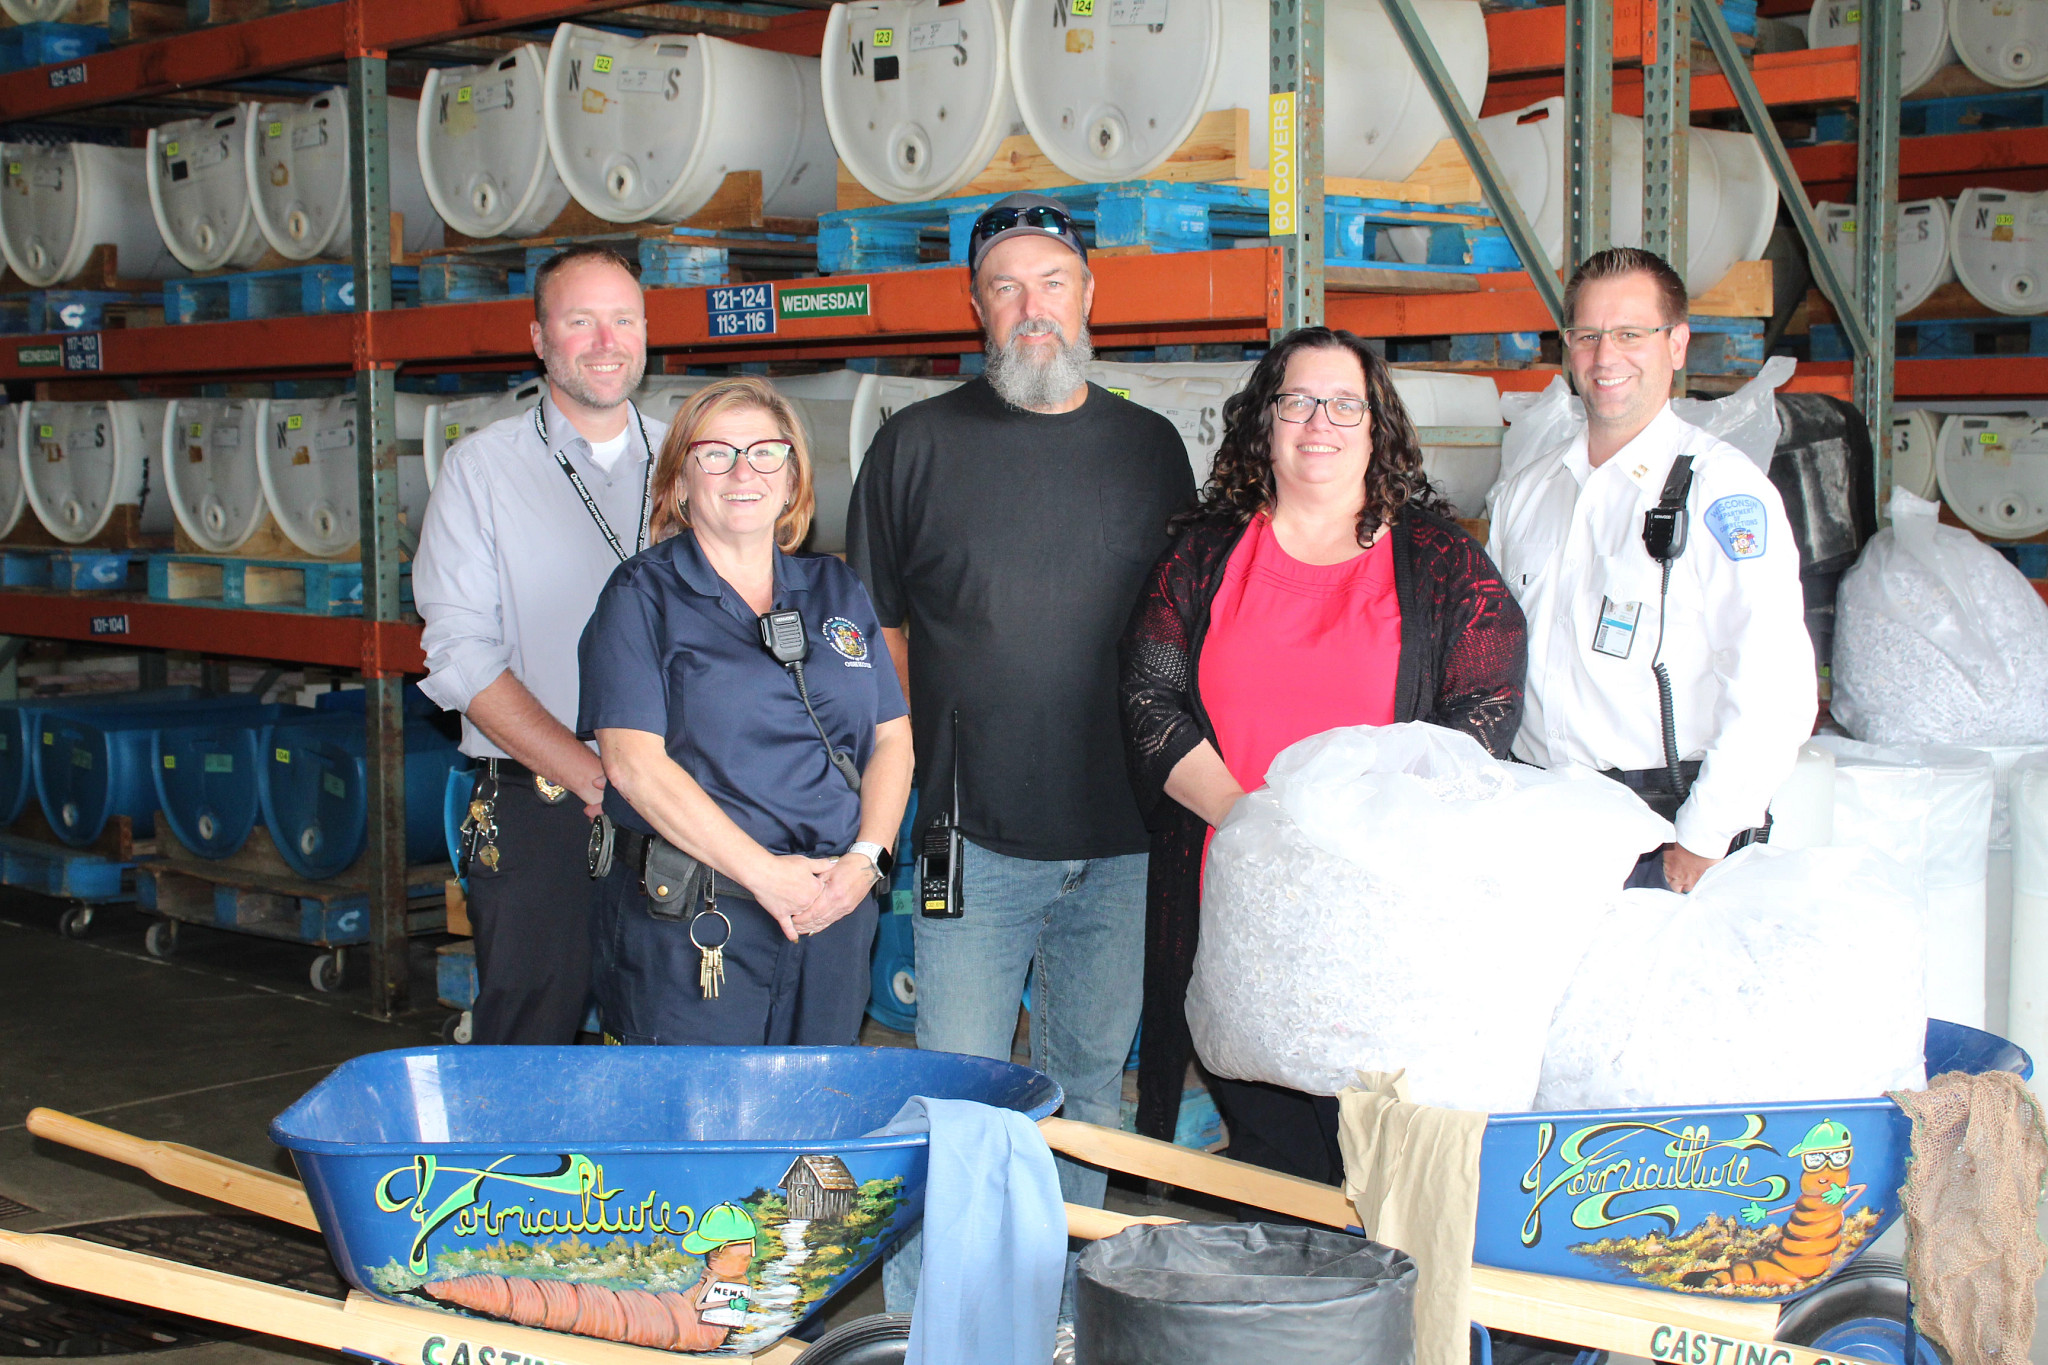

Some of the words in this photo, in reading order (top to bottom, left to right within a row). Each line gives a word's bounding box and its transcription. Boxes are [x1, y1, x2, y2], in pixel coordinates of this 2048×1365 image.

[1075, 0, 1091, 12] 124
[876, 32, 890, 43] 123
[597, 58, 610, 70] 122
[852, 40, 864, 76] N
[569, 59, 581, 91] N
[665, 68, 681, 101] S
[439, 92, 449, 124] N
[1274, 98, 1290, 195] COVERS
[1274, 201, 1290, 231] 60
[1976, 208, 1988, 229] N
[1827, 222, 1838, 244] N
[1917, 220, 1929, 242] S
[713, 287, 766, 310] 121-124
[782, 292, 865, 312] WEDNESDAY
[717, 312, 766, 334] 113-116
[66, 336, 96, 350] 117-120
[18, 349, 60, 363] WEDNESDAY
[68, 354, 97, 369] 109-112
[95, 423, 105, 448] S
[277, 421, 287, 449] N
[1198, 407, 1216, 446] S
[570, 472, 590, 501] Oshkosh
[586, 500, 615, 540] Correctional
[1710, 499, 1758, 519] WISCONSIN
[1717, 507, 1755, 521] DEPARTMENT
[1719, 518, 1759, 534] CORRECTIONS
[93, 617, 123, 632] 101-104
[277, 750, 288, 761] 104
[1520, 1113, 1791, 1248] Vermiculture
[375, 1154, 696, 1276] Vermiculture
[714, 1286, 745, 1297] NEWS
